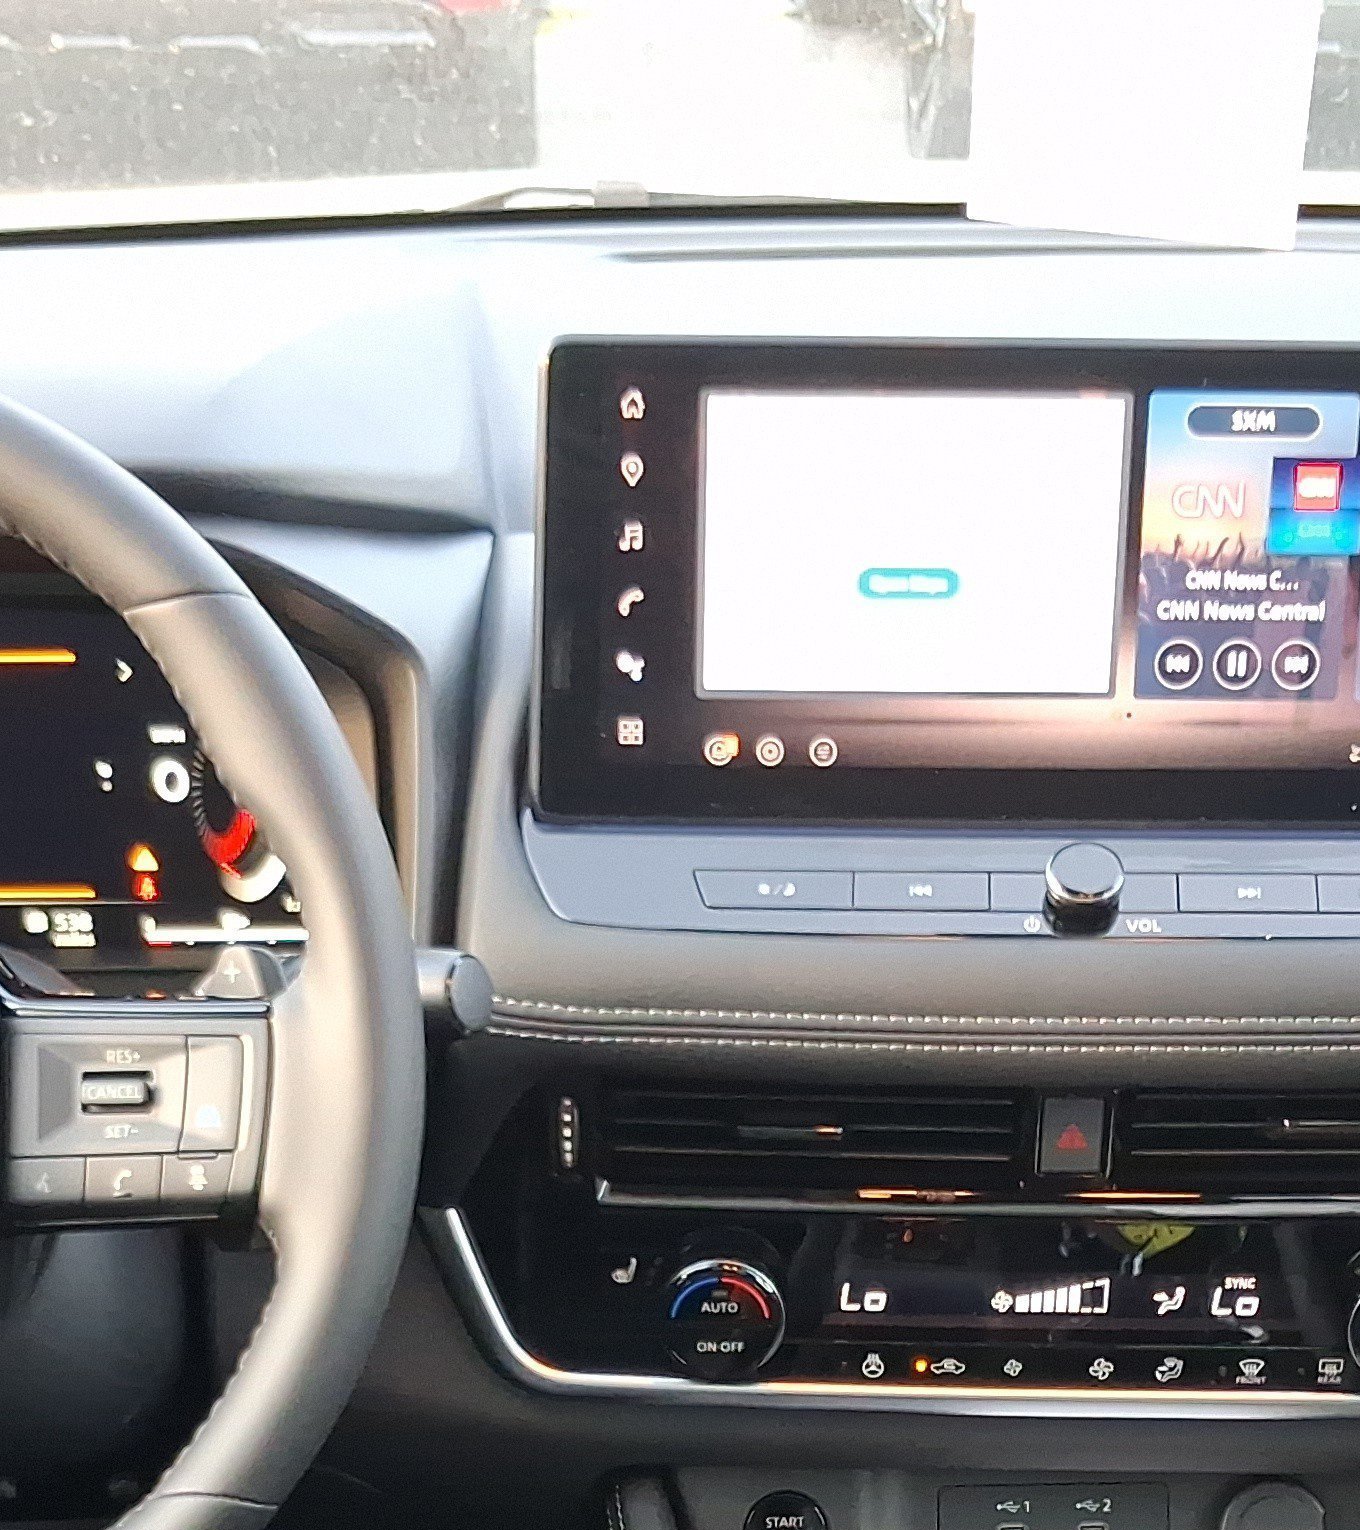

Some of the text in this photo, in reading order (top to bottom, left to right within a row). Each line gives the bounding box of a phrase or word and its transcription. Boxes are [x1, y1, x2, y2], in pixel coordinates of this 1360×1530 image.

[1231, 410, 1276, 432] SXM
[1172, 480, 1246, 518] CNN
[1185, 569, 1222, 590] CNN
[1223, 570, 1267, 590] News
[1156, 600, 1326, 621] CNN News Central
[1125, 918, 1163, 933] VOL
[88, 1085, 144, 1100] CANCEL
[1224, 1276, 1257, 1290] SYNC
[700, 1302, 739, 1314] AUTO
[1022, 1500, 1030, 1513] 1
[1102, 1498, 1112, 1513] 2
[765, 1516, 804, 1529] START
